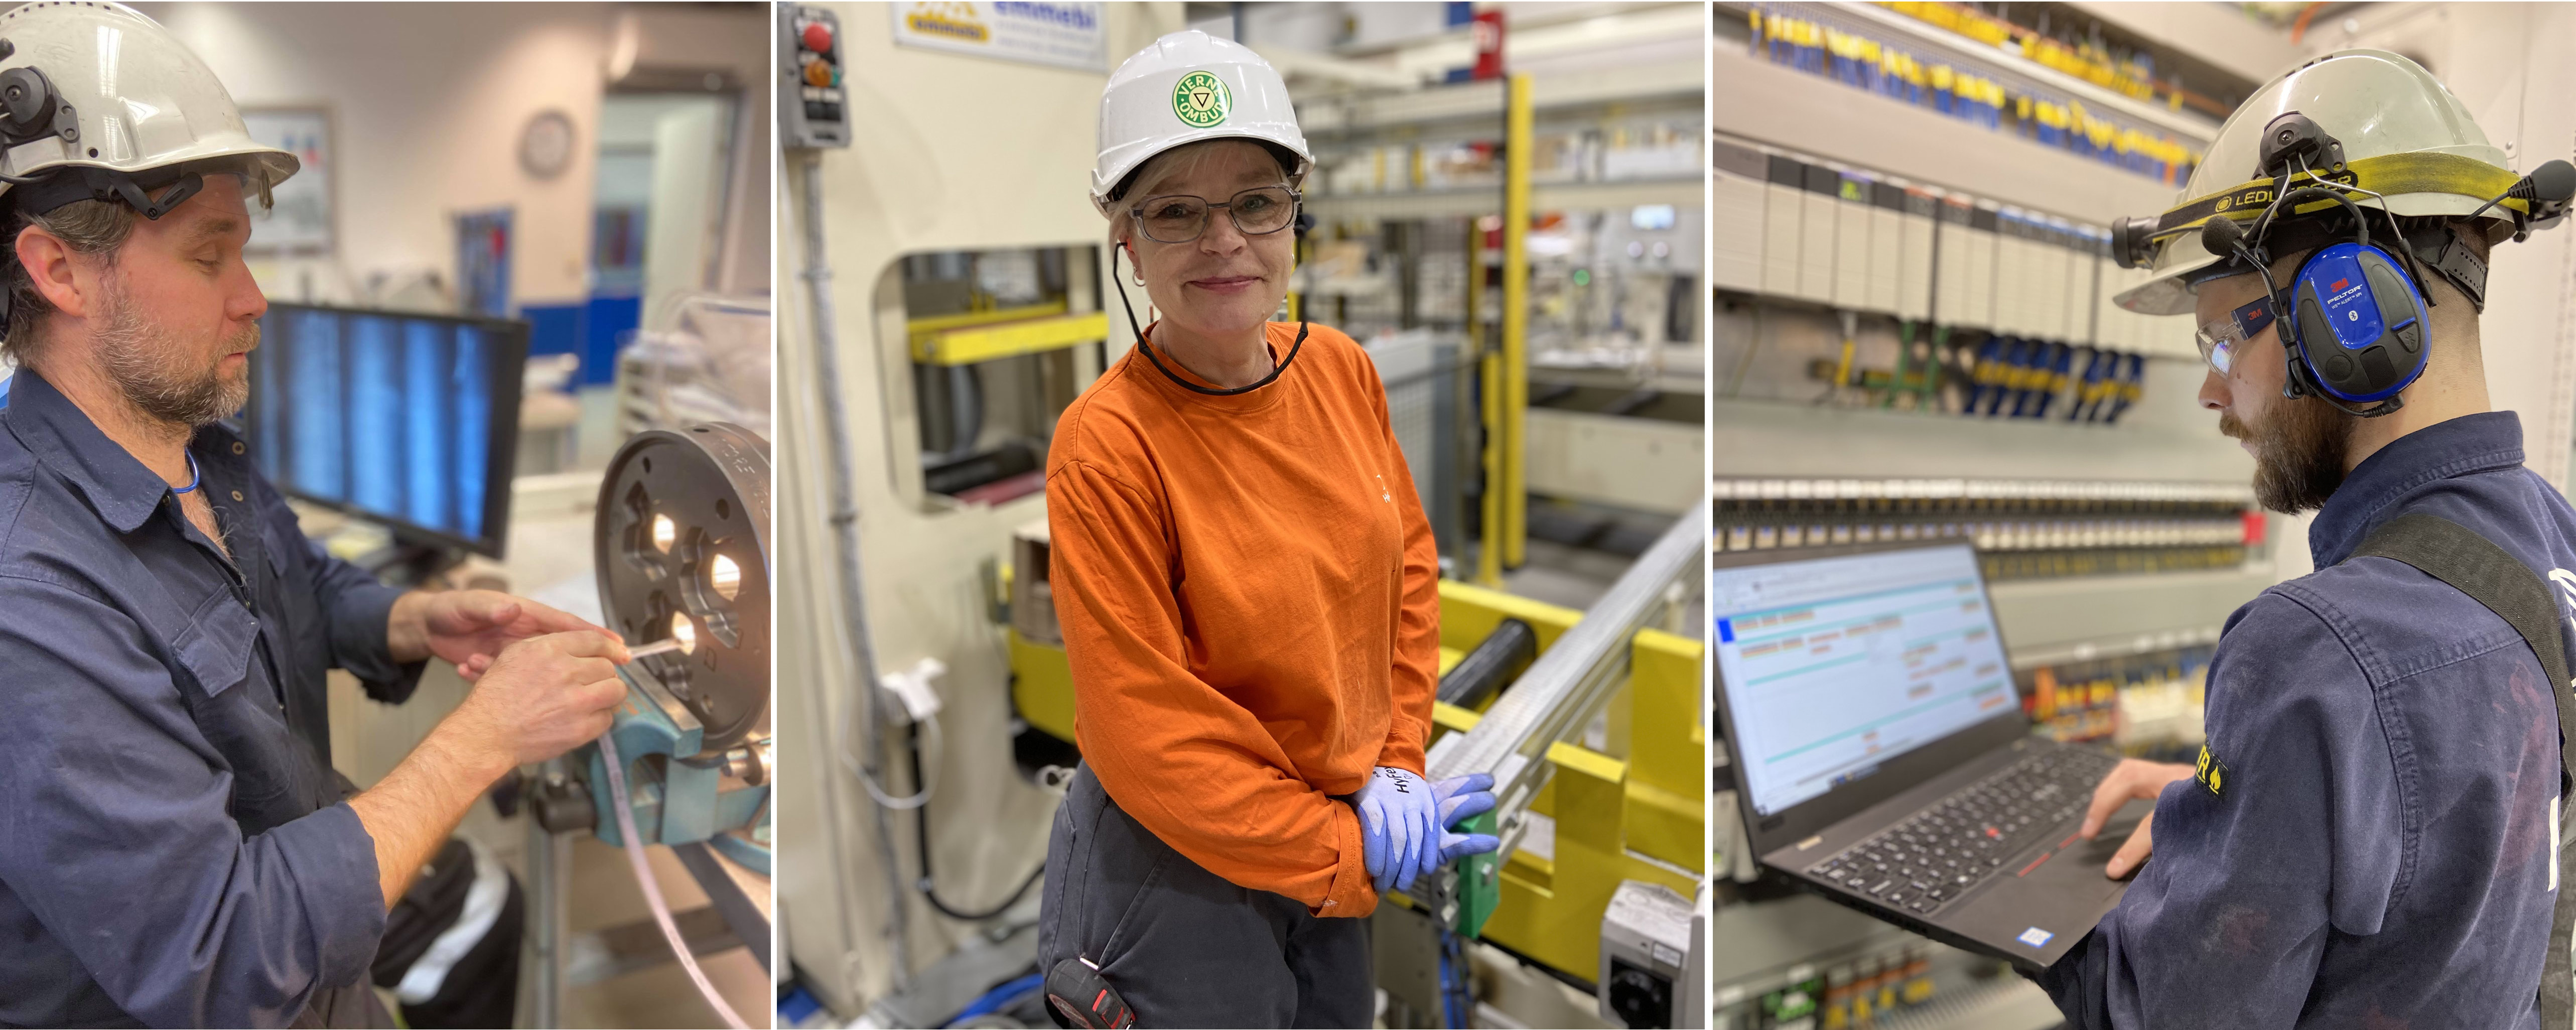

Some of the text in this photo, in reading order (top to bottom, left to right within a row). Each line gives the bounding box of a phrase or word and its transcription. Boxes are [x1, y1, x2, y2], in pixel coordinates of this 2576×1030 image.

[1179, 102, 1225, 123] OMBUD
[2331, 278, 2349, 293] 3M
[2248, 308, 2263, 320] 3M
